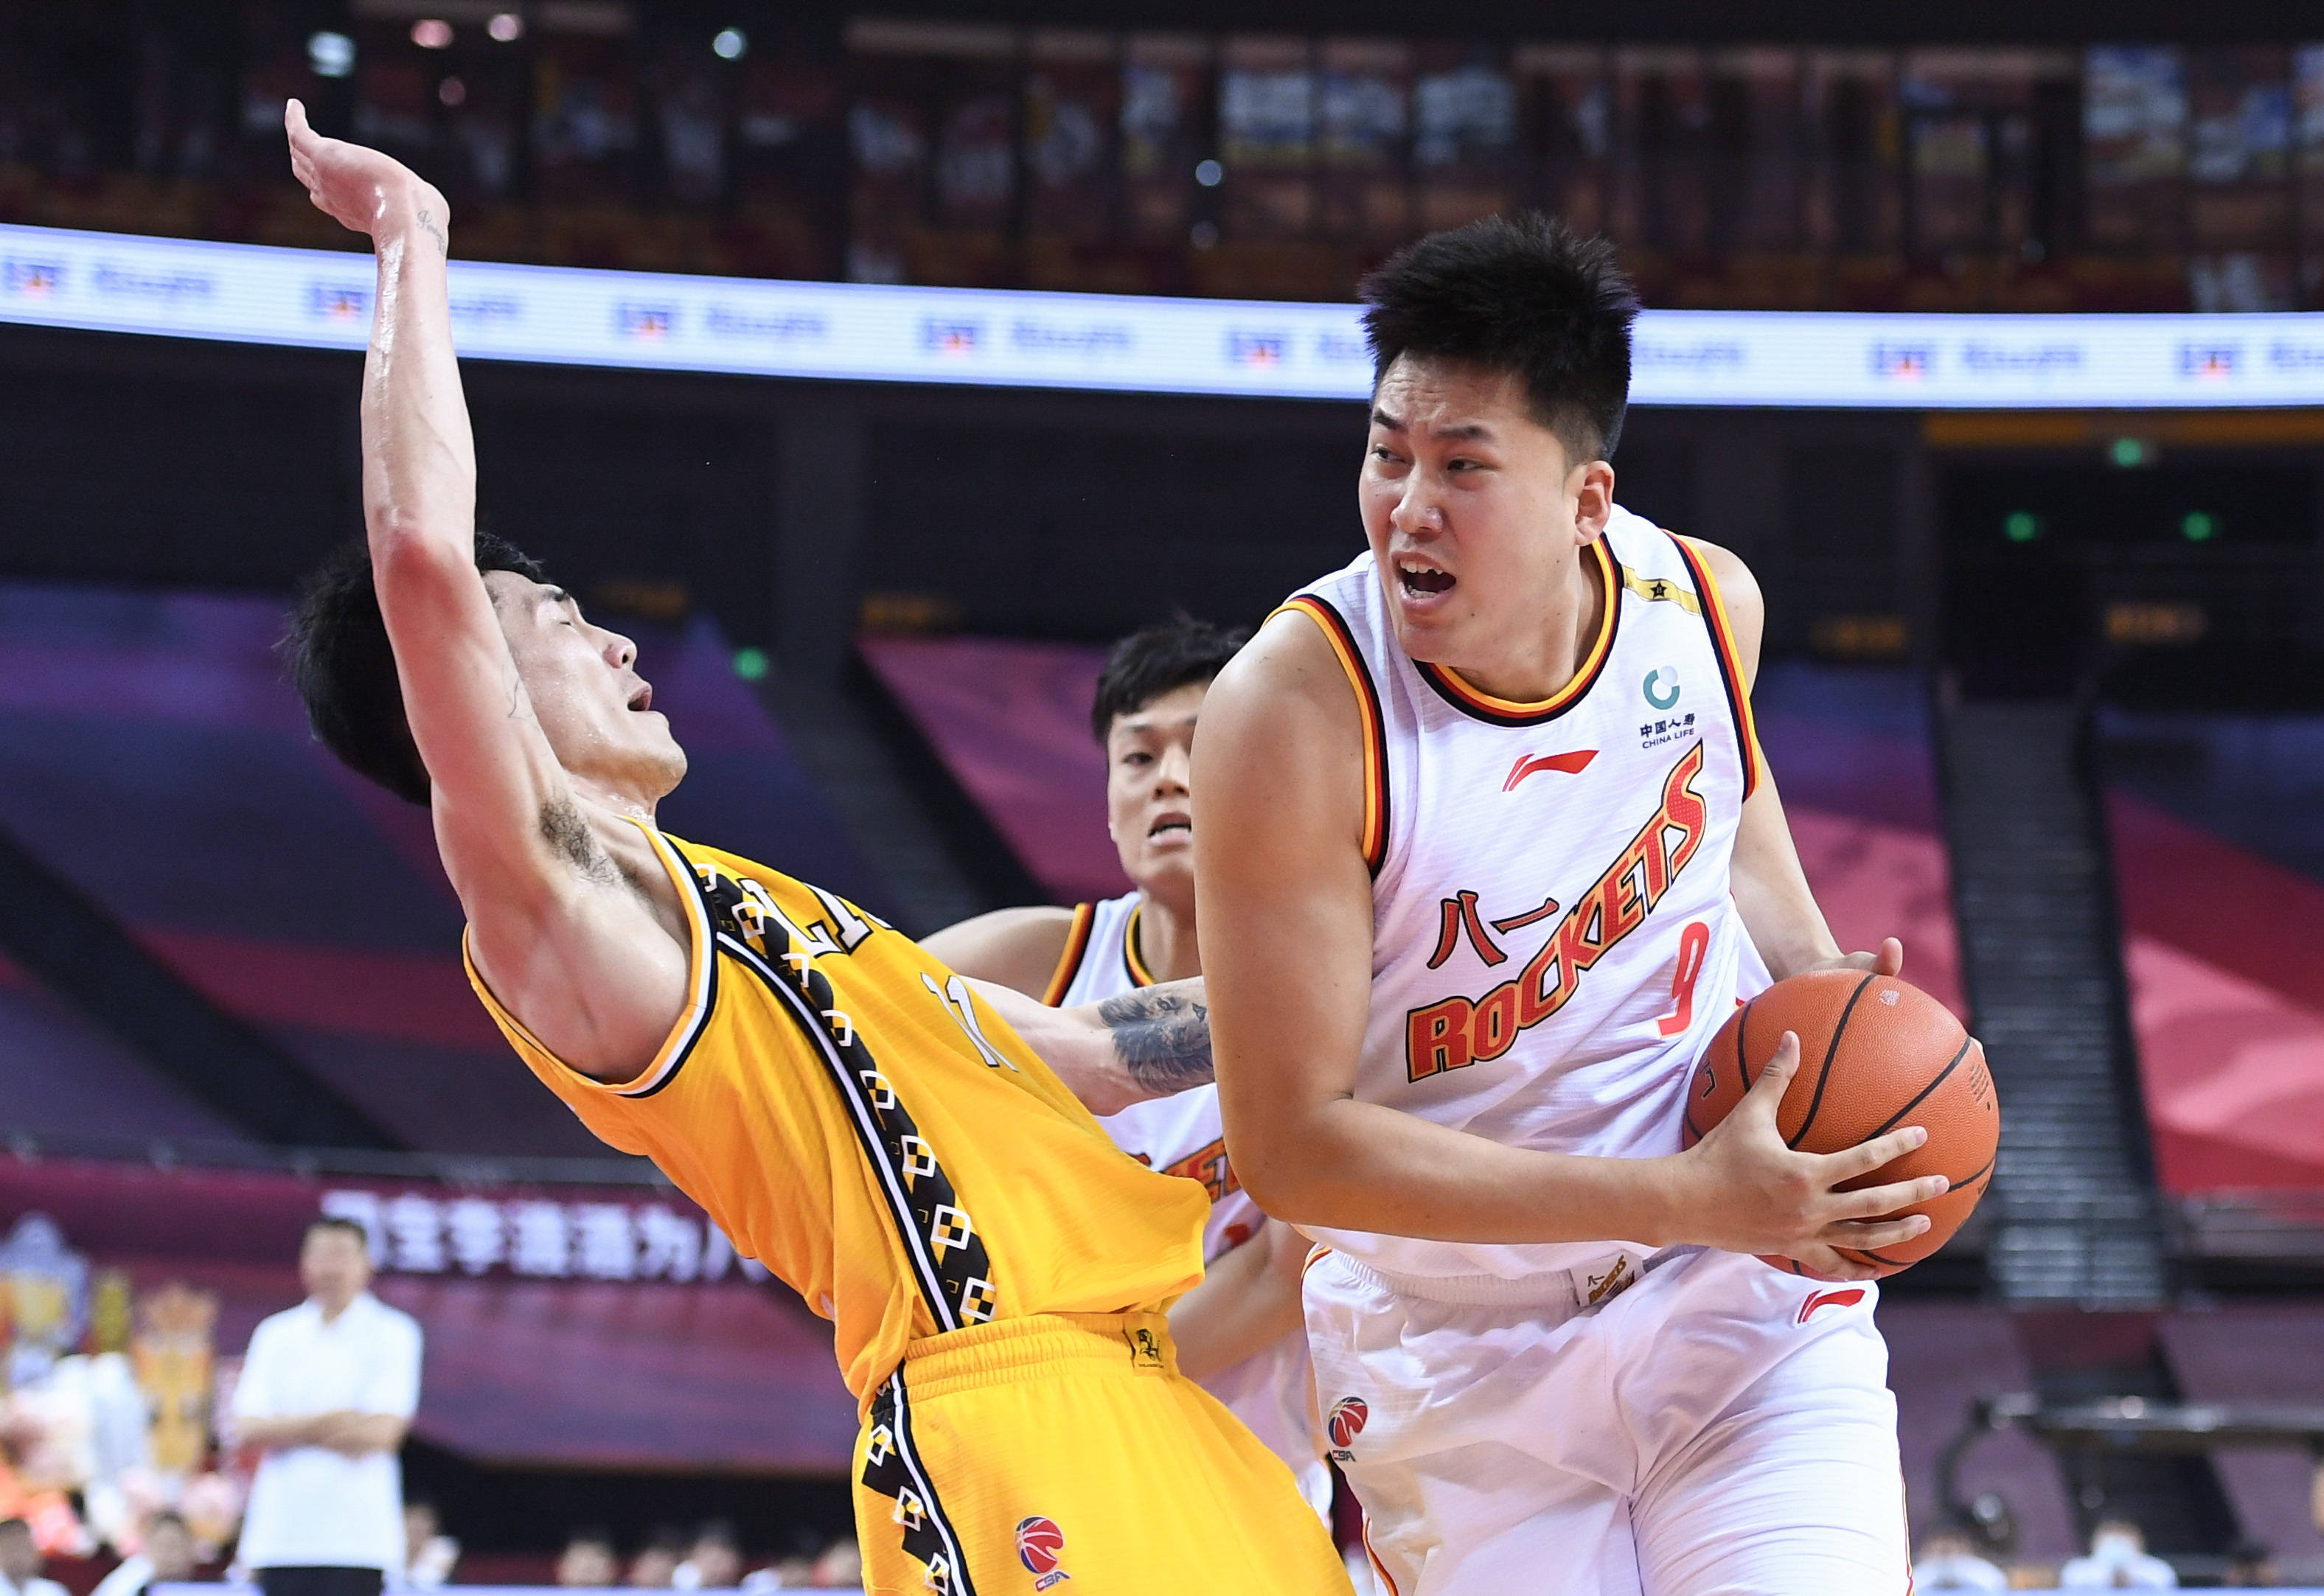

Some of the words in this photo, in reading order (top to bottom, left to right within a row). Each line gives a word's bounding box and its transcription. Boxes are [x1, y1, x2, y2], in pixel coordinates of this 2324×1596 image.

[1640, 713, 1695, 738] 中国人寿
[1642, 735, 1671, 748] CHINA
[1674, 728, 1694, 739] LIFE
[1407, 738, 1706, 1083] ROCKETS
[1426, 889, 1560, 969] 八一
[1657, 921, 1710, 1037] 9
[1332, 1449, 1356, 1463] CBA
[1035, 1570, 1071, 1592] CBA
